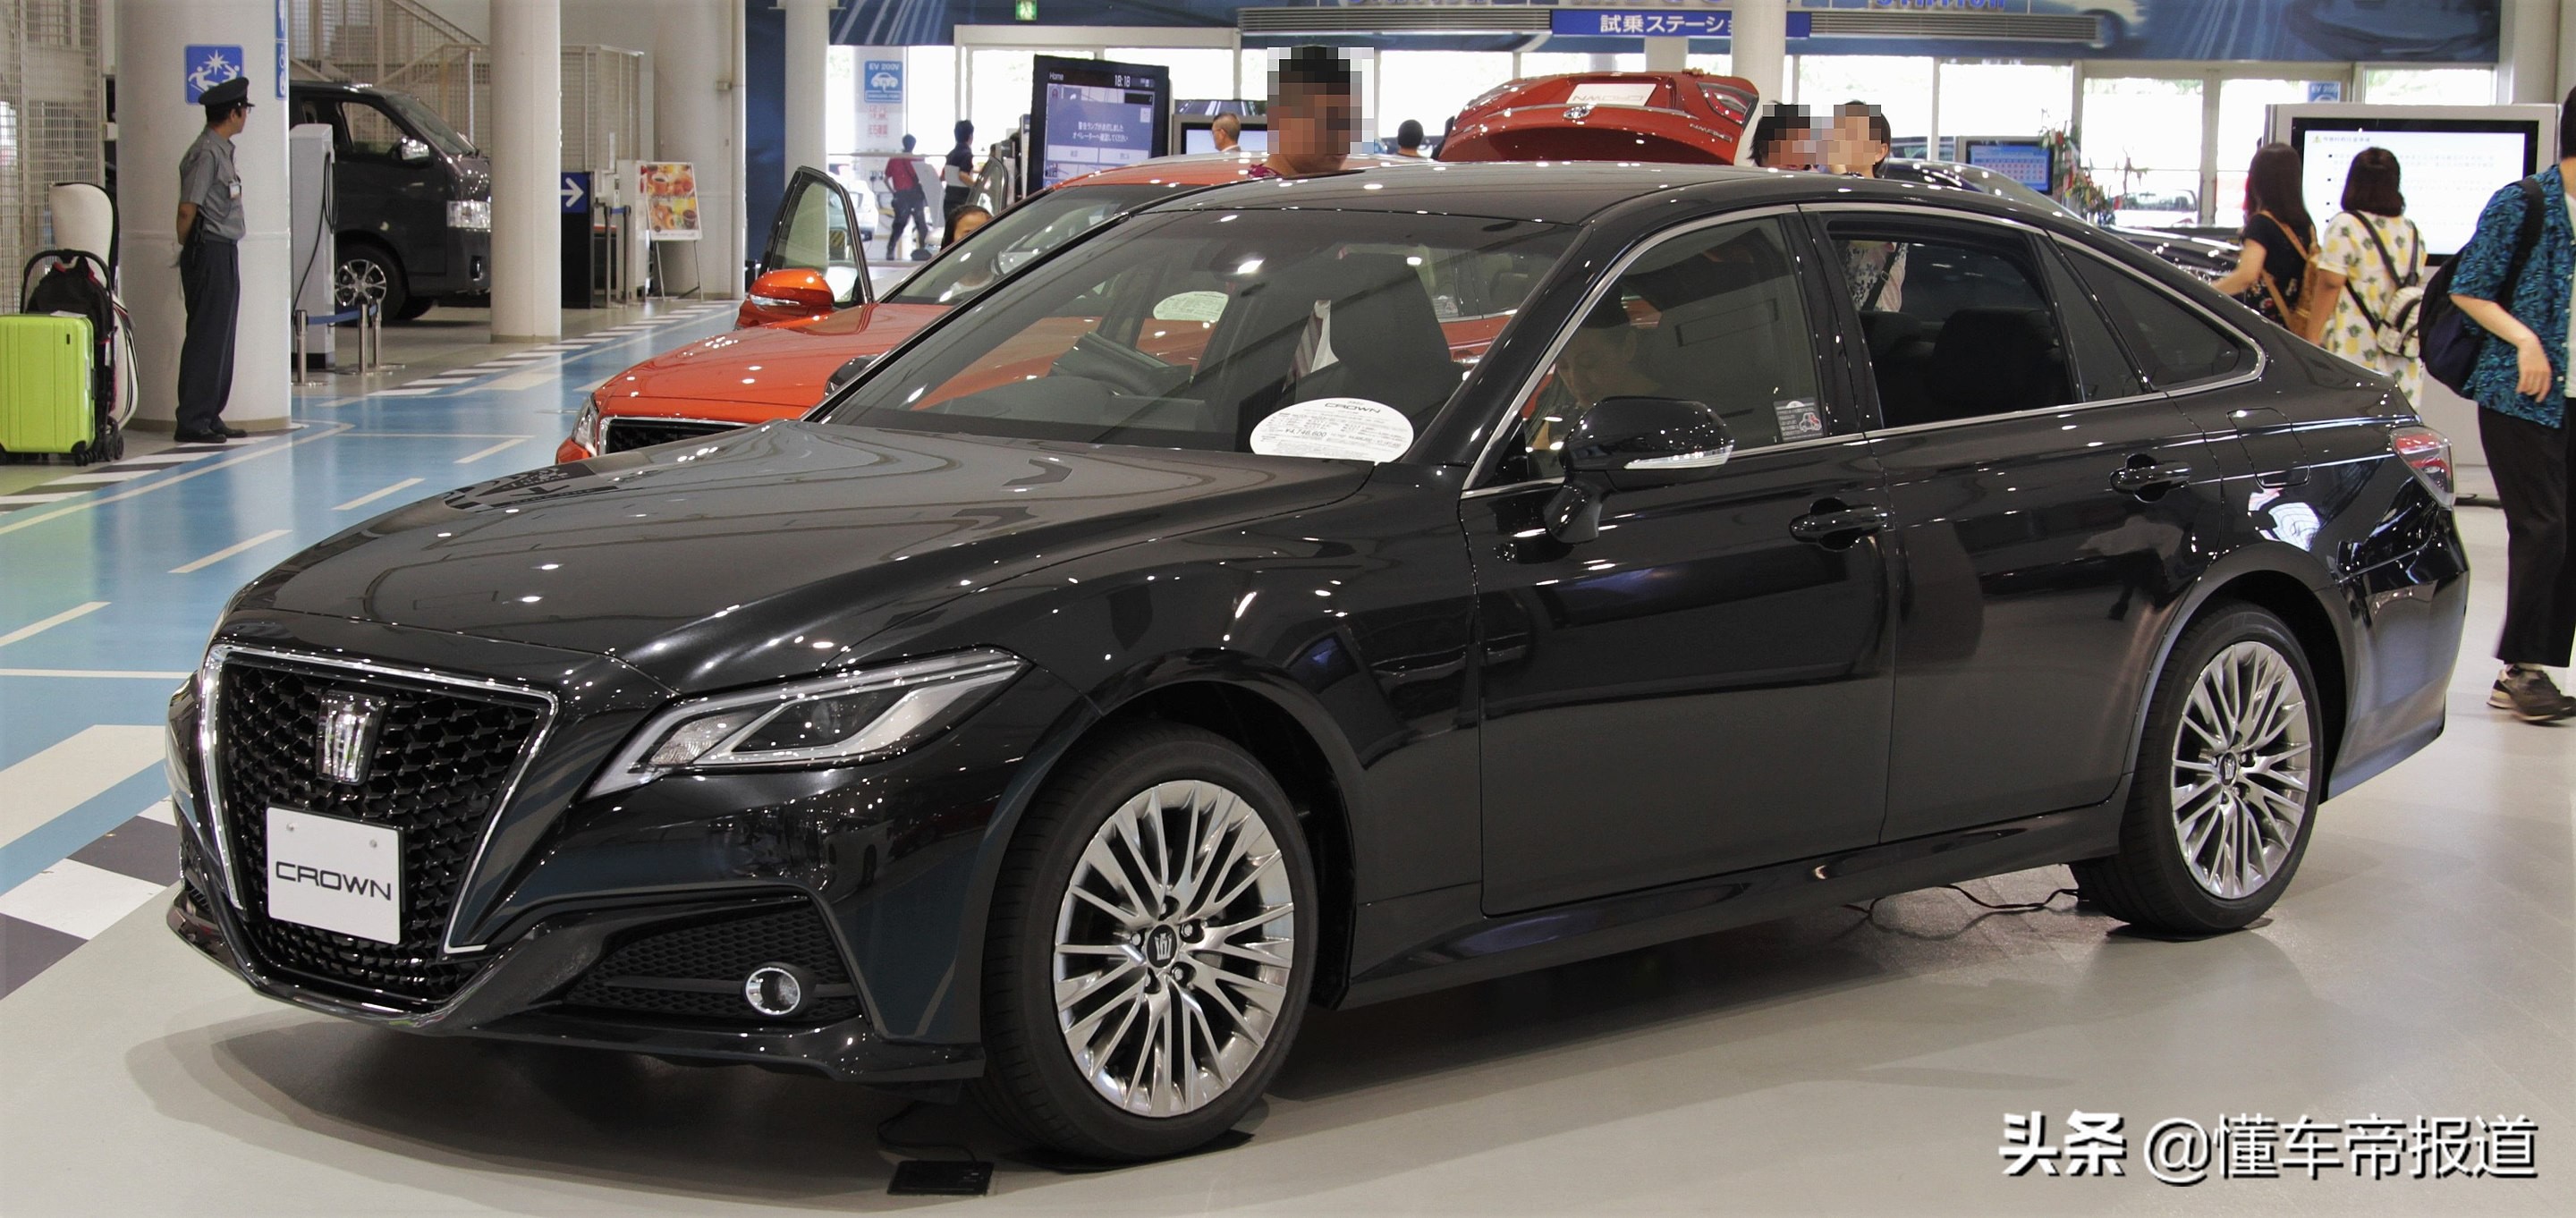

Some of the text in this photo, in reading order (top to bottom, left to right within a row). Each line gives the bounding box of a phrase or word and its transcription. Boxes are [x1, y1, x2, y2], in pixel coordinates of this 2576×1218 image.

[869, 63, 879, 71] EV
[1049, 72, 1064, 80] Home
[1114, 74, 1131, 88] 18:18
[1325, 402, 1381, 413] CROWN
[275, 860, 392, 901] CROWN
